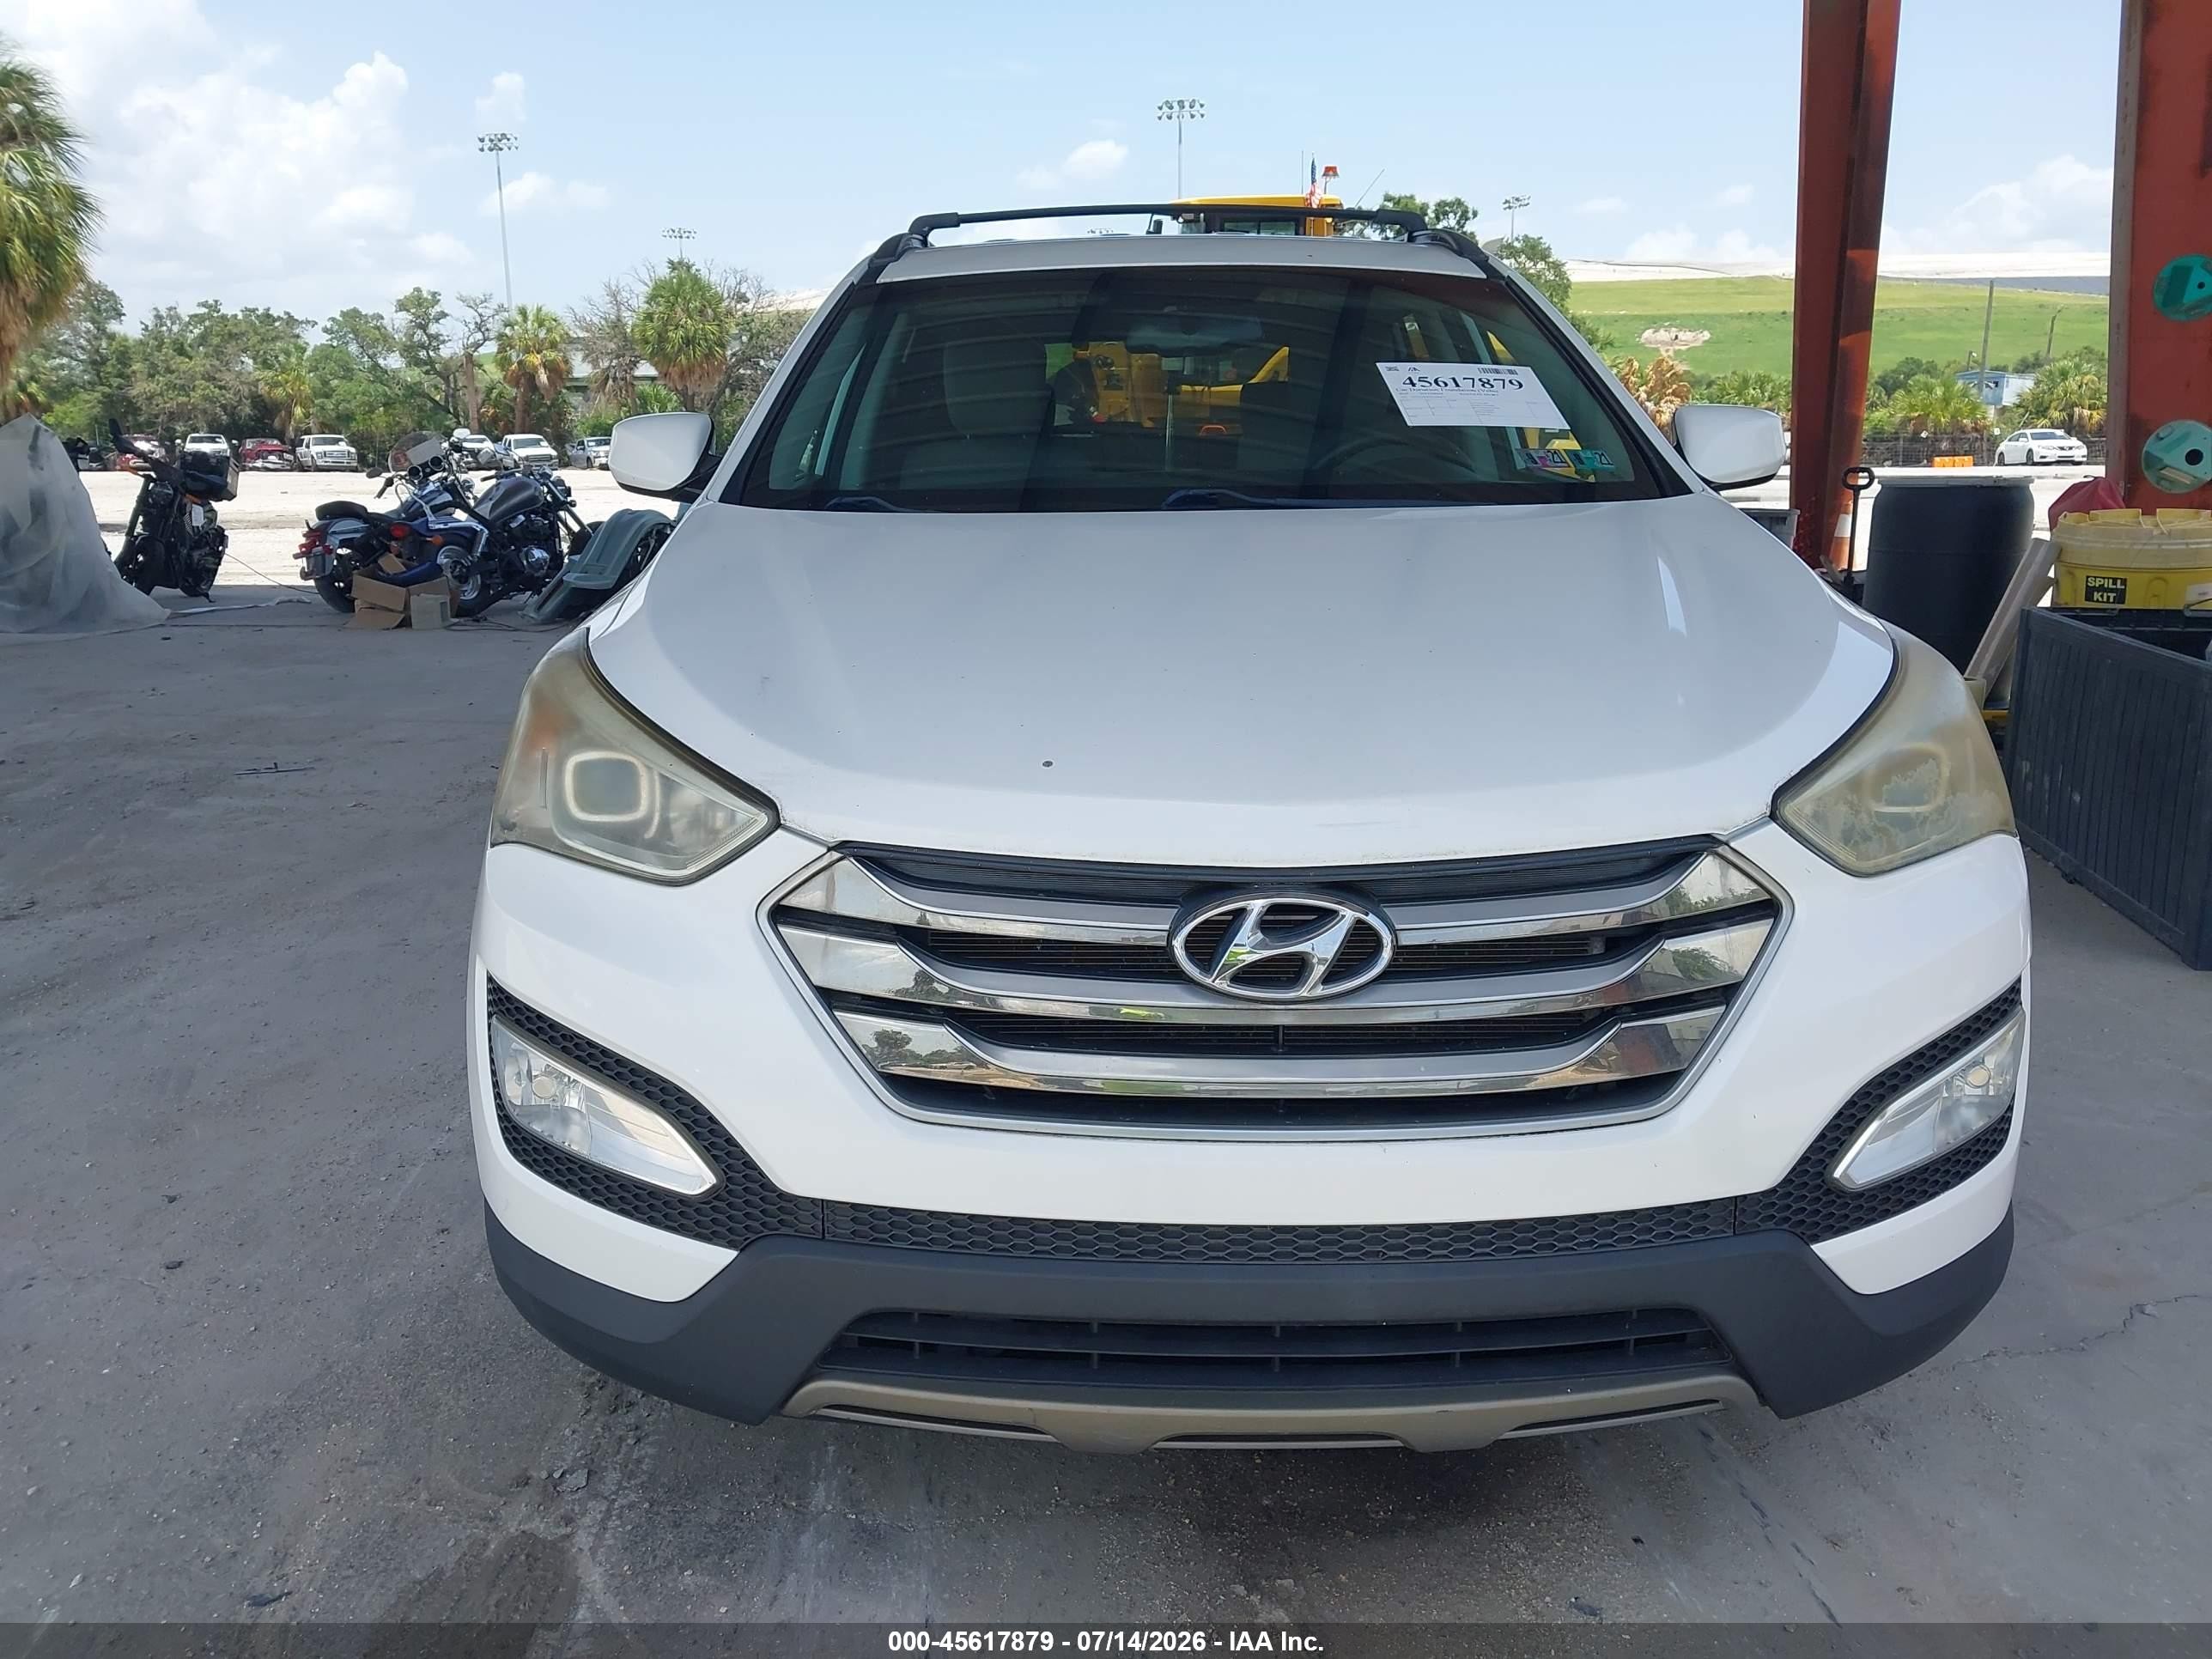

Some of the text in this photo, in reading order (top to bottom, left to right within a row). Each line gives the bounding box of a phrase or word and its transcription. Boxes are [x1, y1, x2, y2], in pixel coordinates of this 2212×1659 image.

[1402, 376, 1523, 390] 45617879
[1547, 451, 1567, 464] 21
[1594, 452, 1613, 465] 21
[2087, 576, 2125, 589] SPILL
[2093, 591, 2117, 602] KIT
